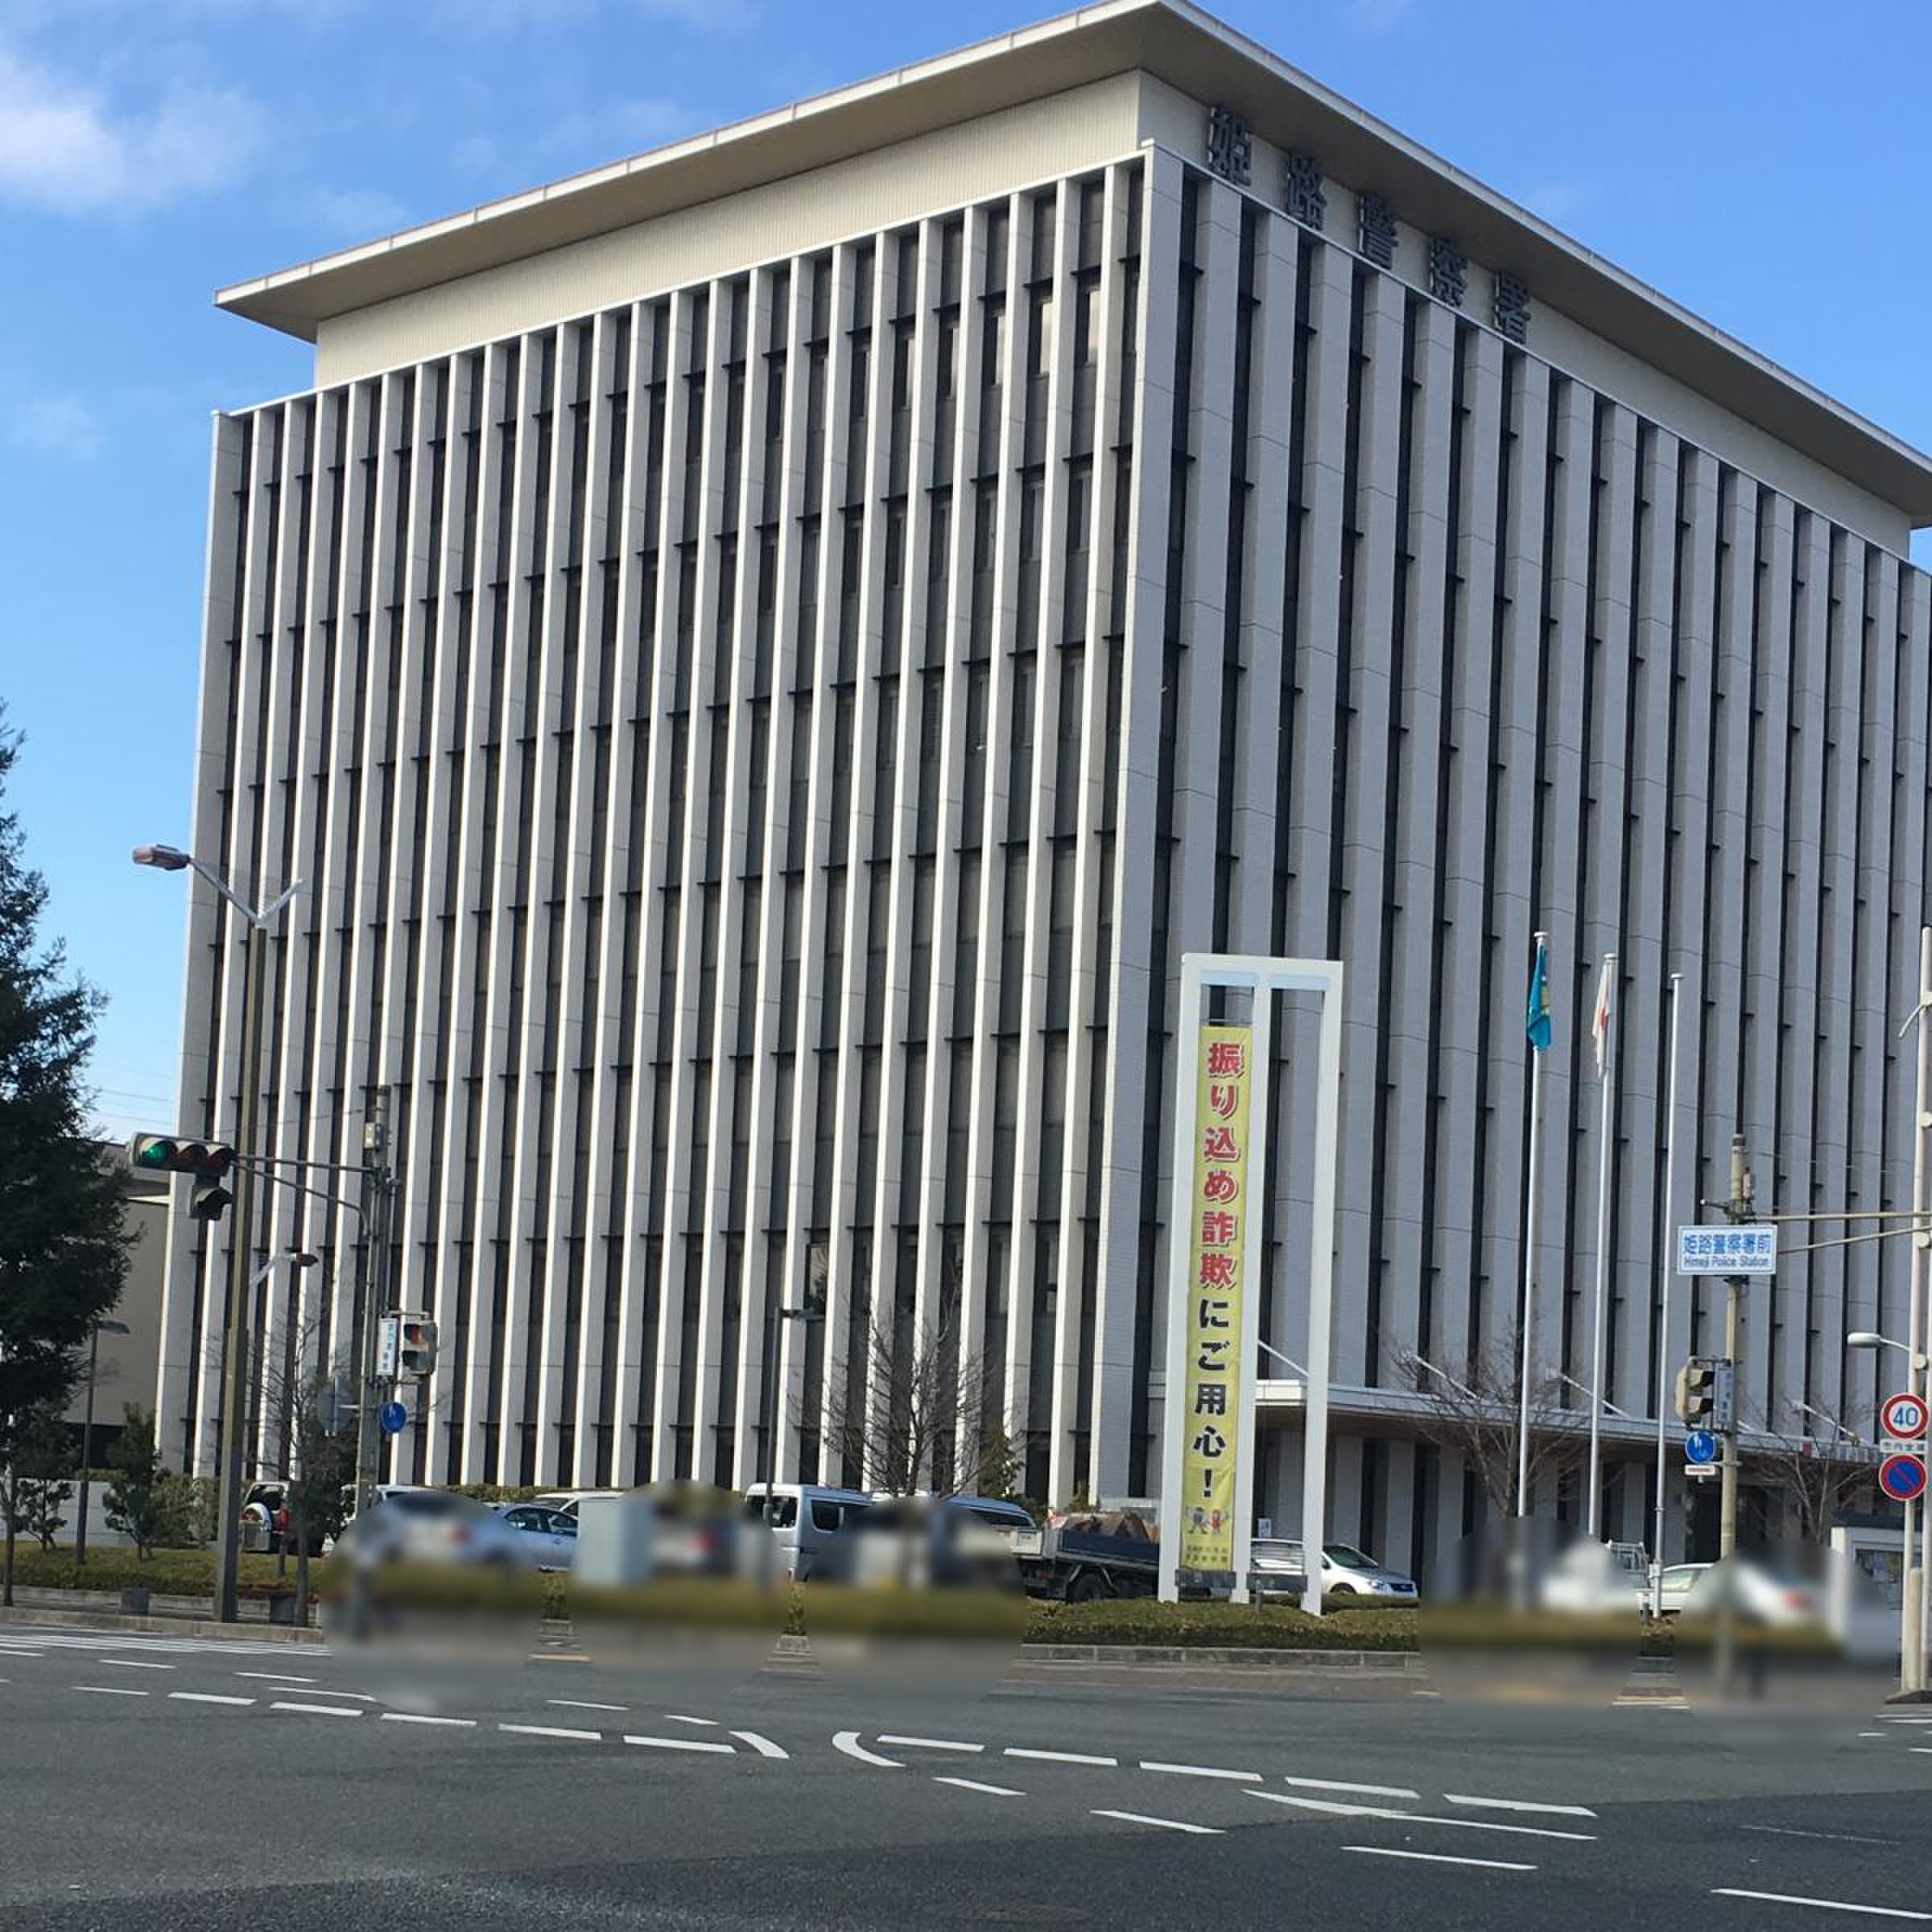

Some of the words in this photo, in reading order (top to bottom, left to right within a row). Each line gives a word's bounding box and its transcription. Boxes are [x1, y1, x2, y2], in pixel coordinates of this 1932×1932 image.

[1208, 103, 1532, 345] 姫路警察署
[1893, 1406, 1918, 1426] 40
